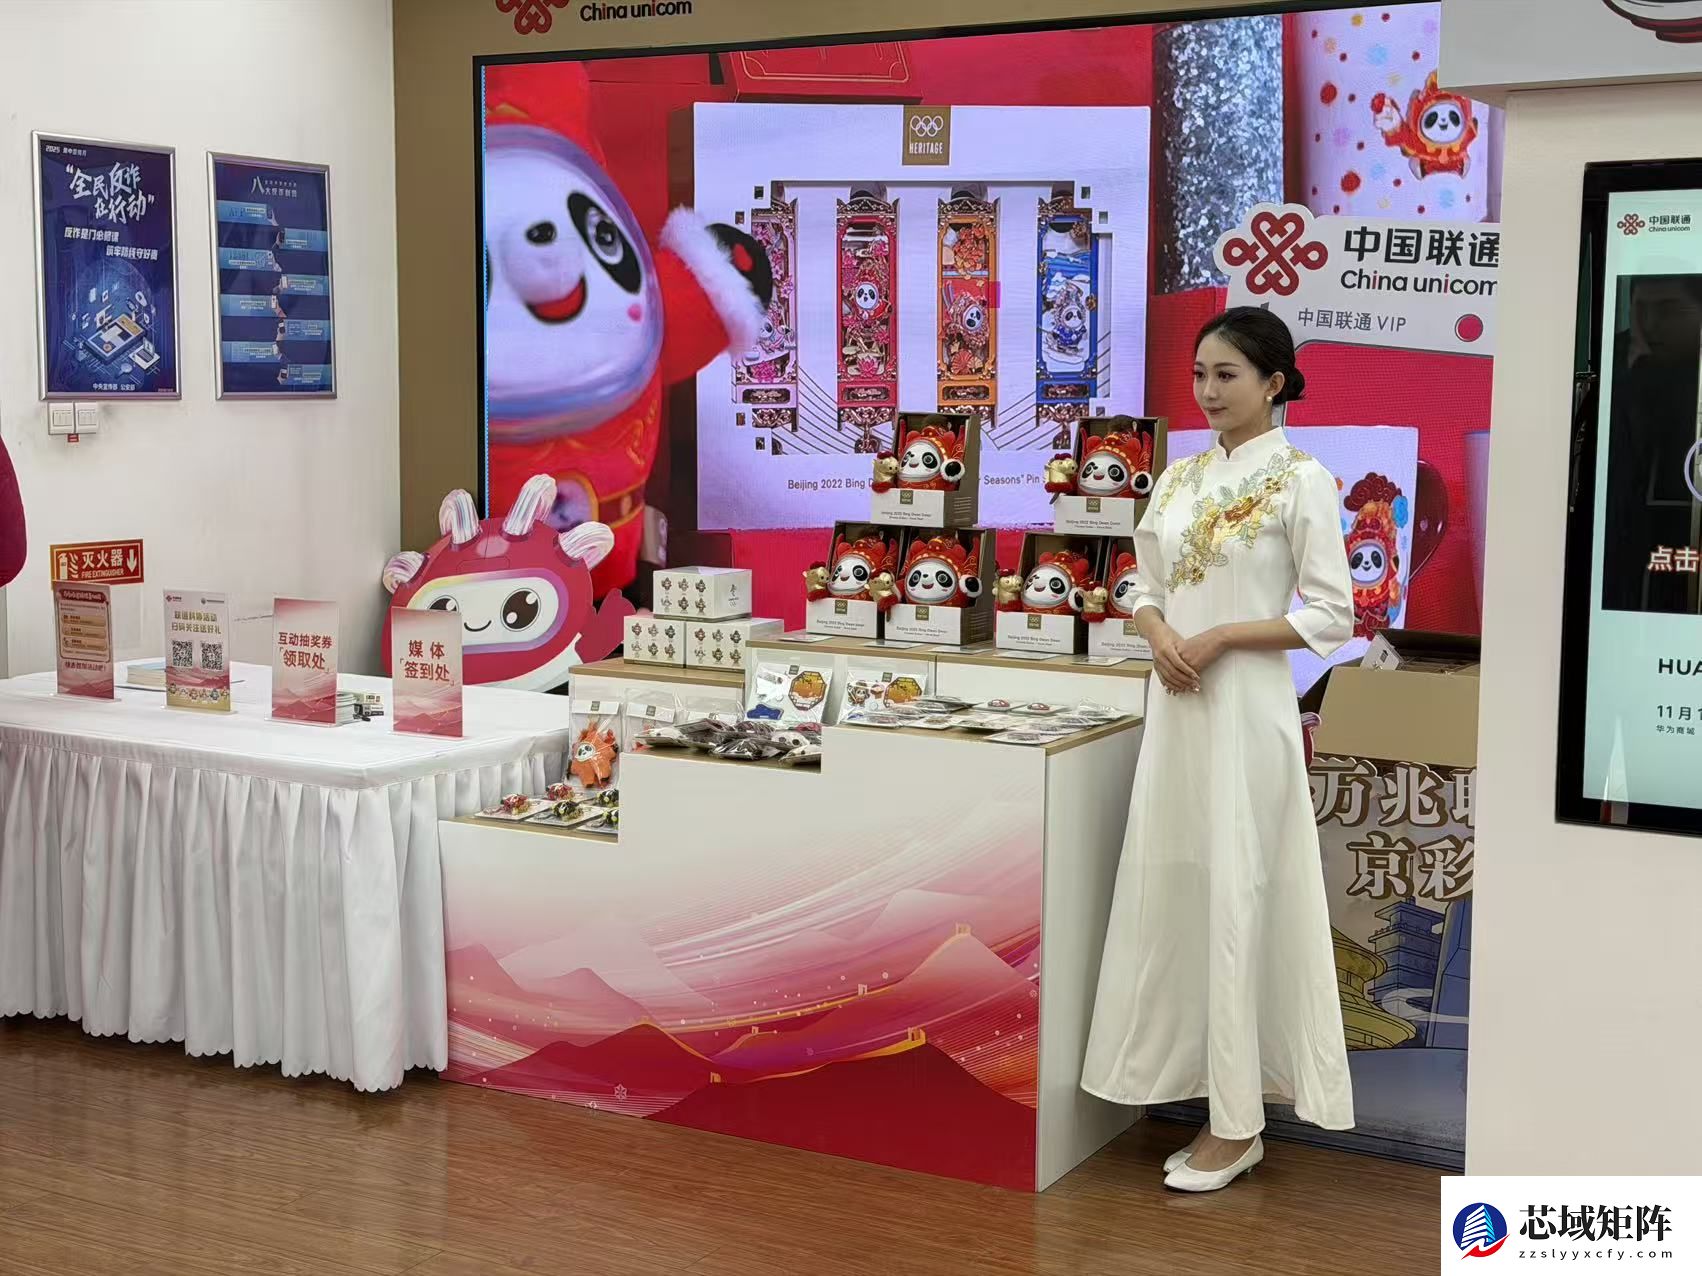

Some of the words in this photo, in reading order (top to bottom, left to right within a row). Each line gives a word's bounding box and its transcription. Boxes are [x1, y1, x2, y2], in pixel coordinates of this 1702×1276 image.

[580, 4, 627, 22] China
[631, 1, 692, 19] unicom
[909, 142, 943, 154] HERITAGE
[1648, 214, 1691, 225] 中国联通
[1344, 226, 1500, 268] 中国联通
[1340, 269, 1407, 292] China
[1298, 308, 1372, 332] 中国联通
[1377, 316, 1407, 332] VIP
[788, 480, 818, 490] Beijing
[821, 479, 843, 489] 2022
[845, 479, 866, 490] Bing
[1026, 475, 1040, 485] Pin
[82, 548, 123, 569] 灭火器
[1648, 545, 1699, 572] 点击
[93, 568, 124, 577] EXTINGUISHER
[278, 632, 332, 649] 互动抽奖券
[1656, 724, 1695, 735] 华为商城
[1346, 831, 1475, 900] 京彩
